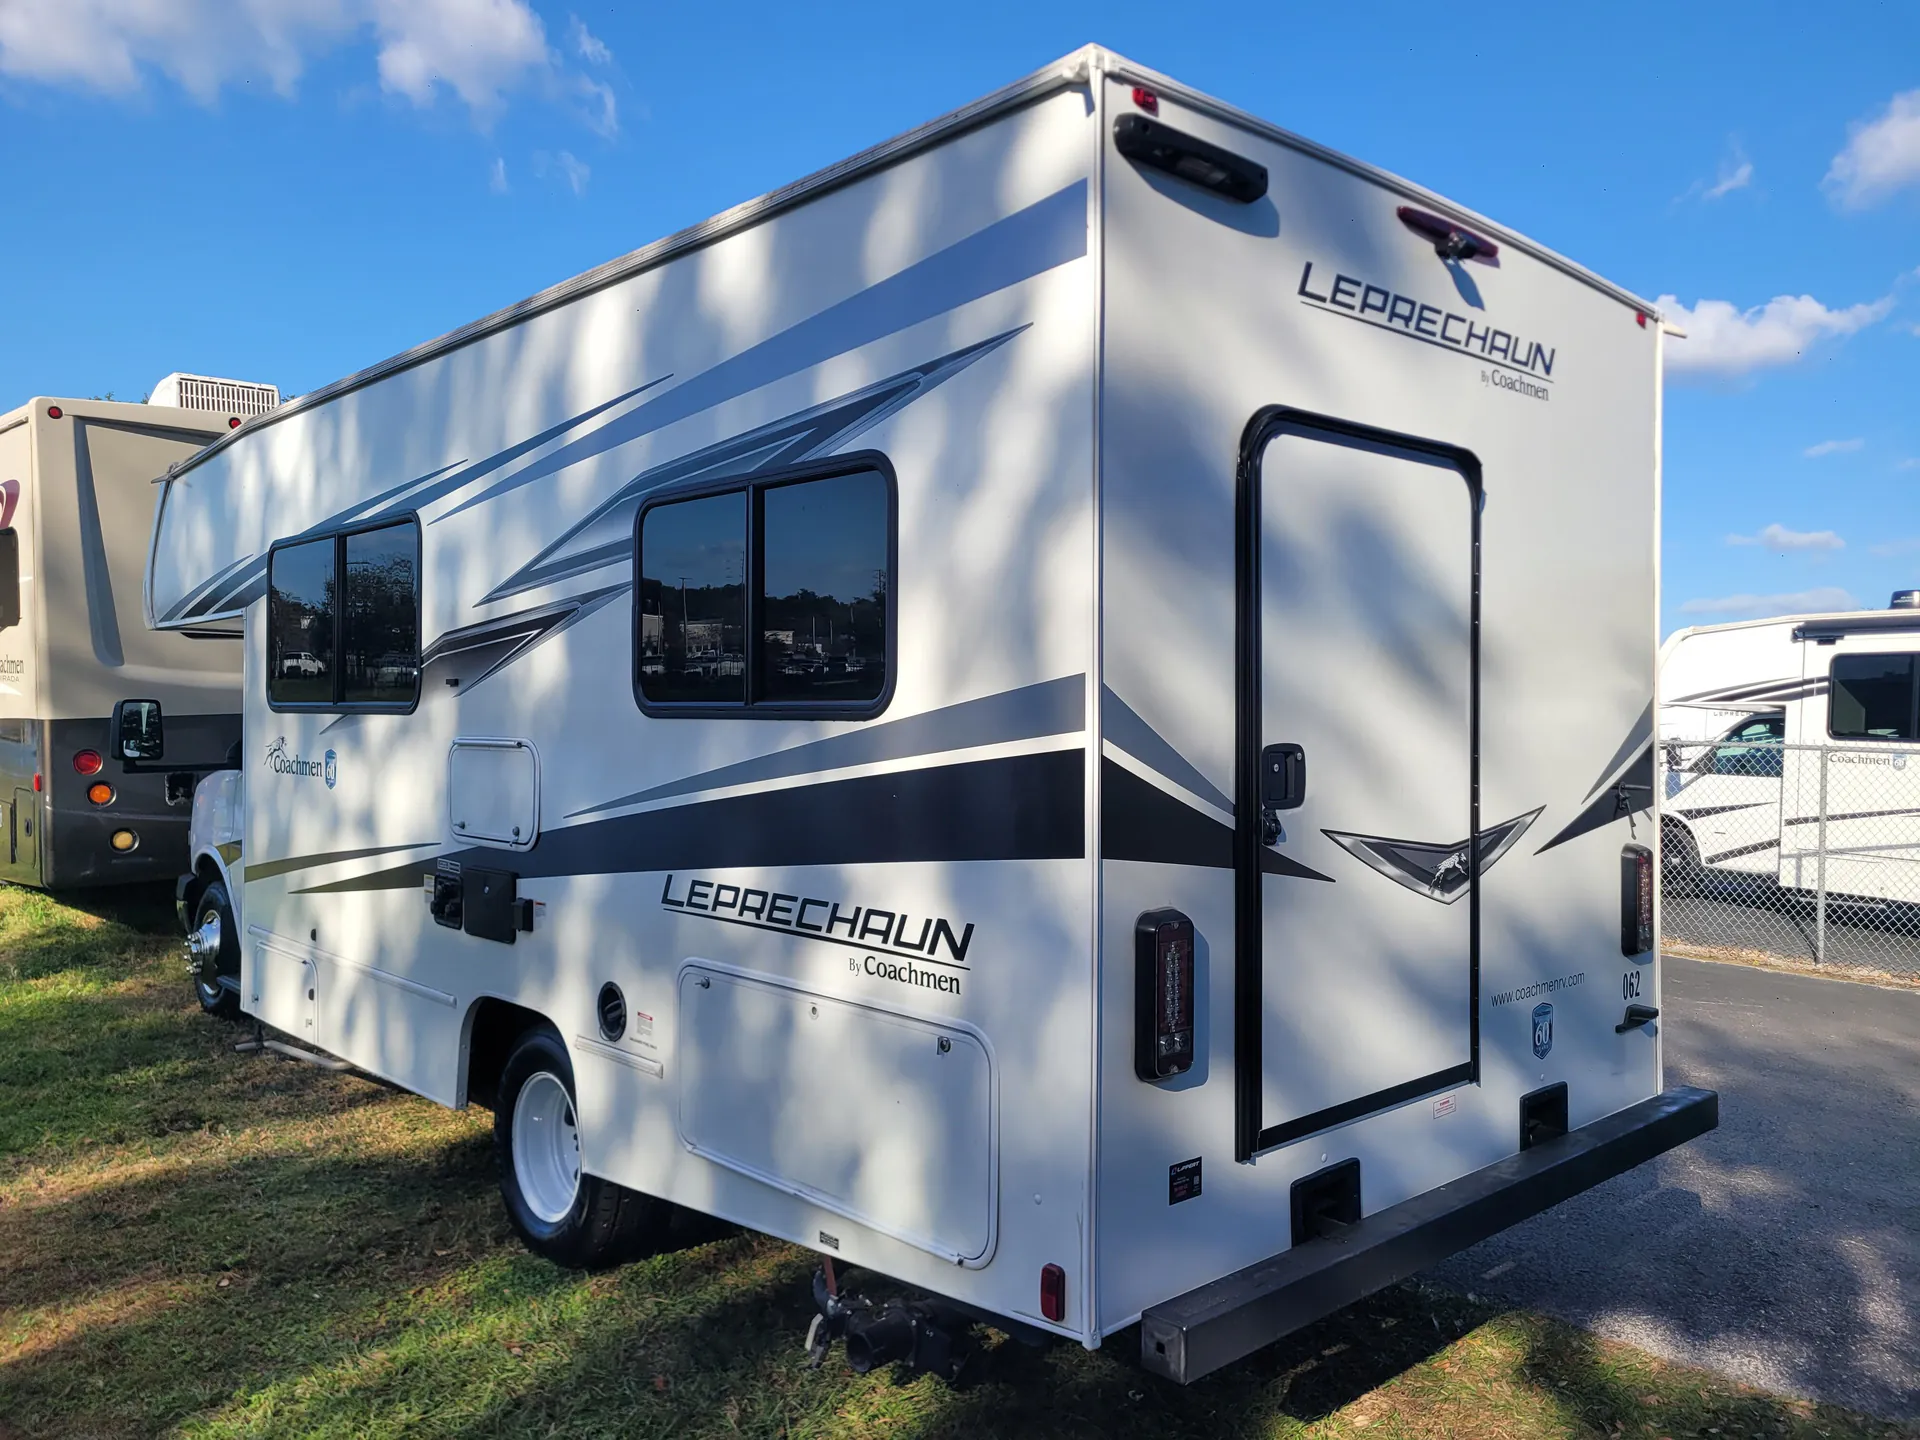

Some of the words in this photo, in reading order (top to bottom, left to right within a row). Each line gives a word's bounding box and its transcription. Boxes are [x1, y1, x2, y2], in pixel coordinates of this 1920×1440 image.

[1298, 261, 1556, 376] LEPRECHAUN
[1481, 370, 1489, 387] By
[1491, 369, 1549, 401] Coachmen
[274, 754, 322, 777] Coachmen
[1829, 753, 1891, 766] Coachmen
[661, 874, 975, 961] LEPRECHAUN
[849, 957, 861, 976] By
[864, 956, 961, 995] Coachmen
[1491, 972, 1585, 1007] www.coachmenrv.com
[1623, 970, 1641, 1000] 062
[1535, 1021, 1550, 1046] 60
